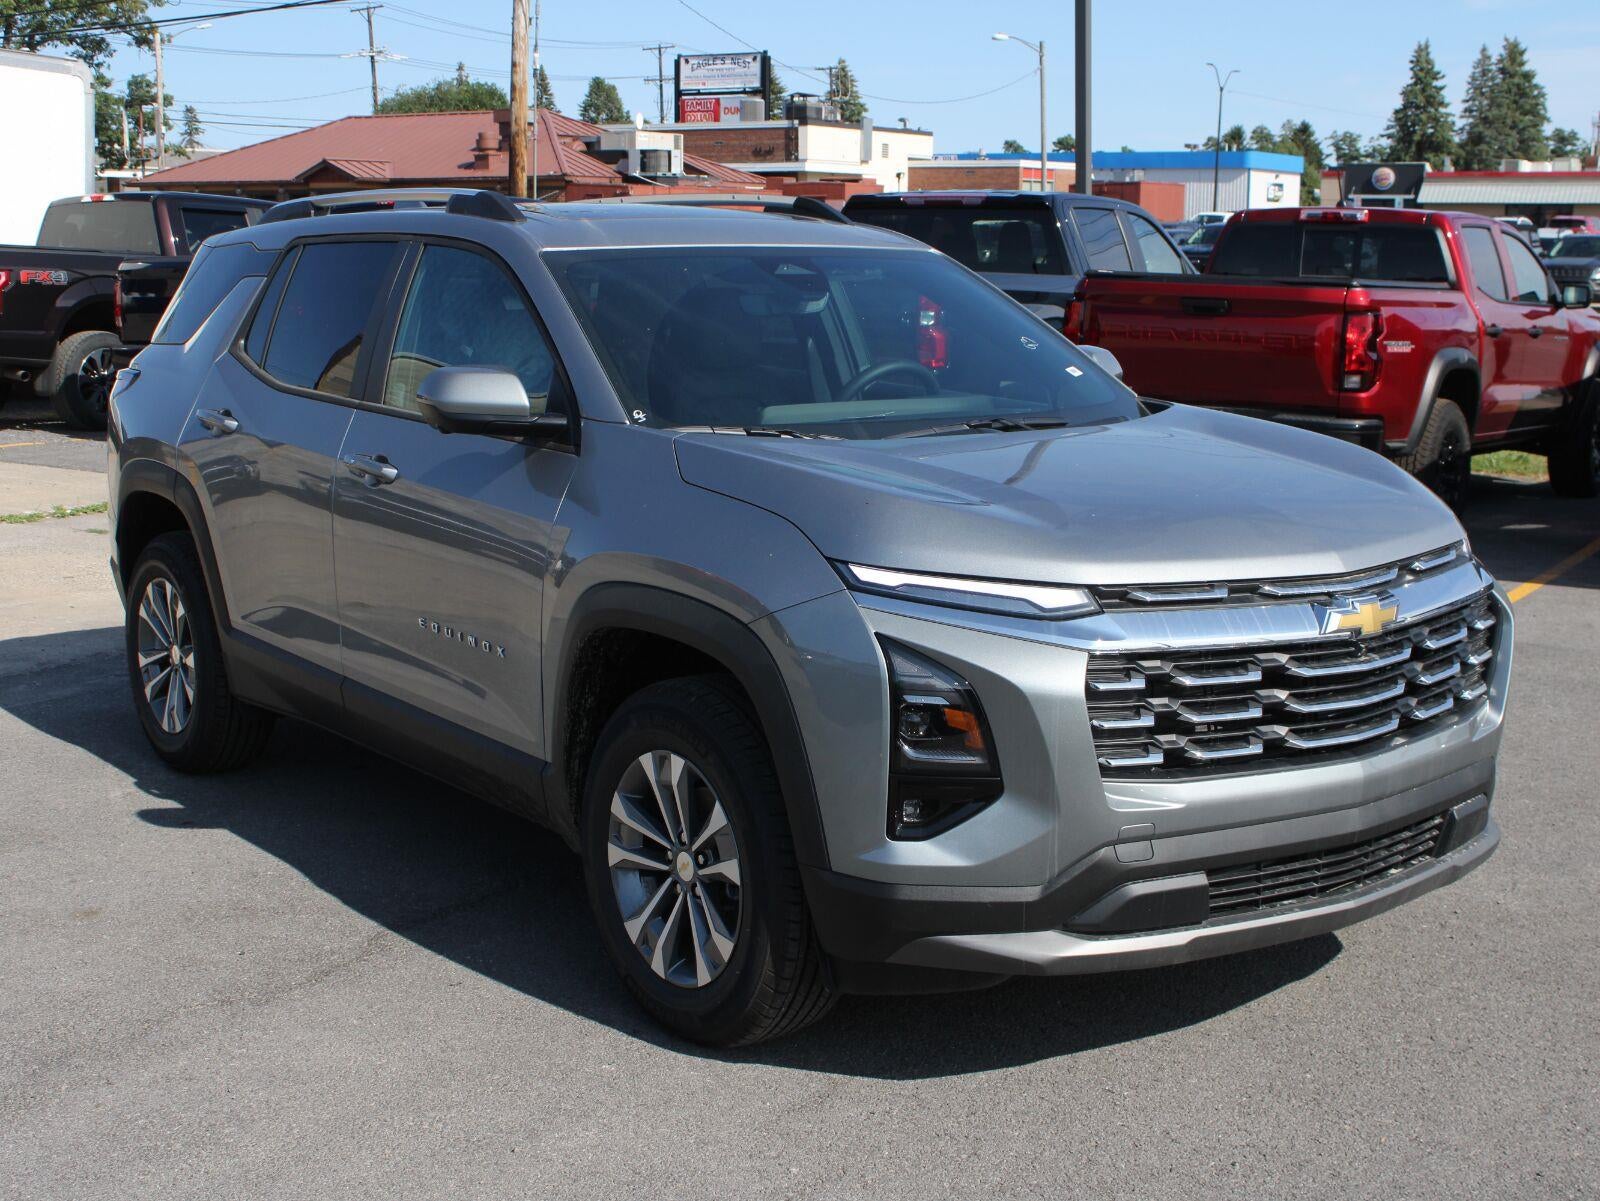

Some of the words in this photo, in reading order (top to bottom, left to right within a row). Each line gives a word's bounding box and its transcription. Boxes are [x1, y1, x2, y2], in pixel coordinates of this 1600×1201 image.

[690, 56, 726, 72] EAGLE'S
[730, 57, 751, 70] NEST
[684, 99, 715, 112] FAMILY
[20, 270, 68, 285] FX4
[418, 617, 506, 658] EQUINOX
